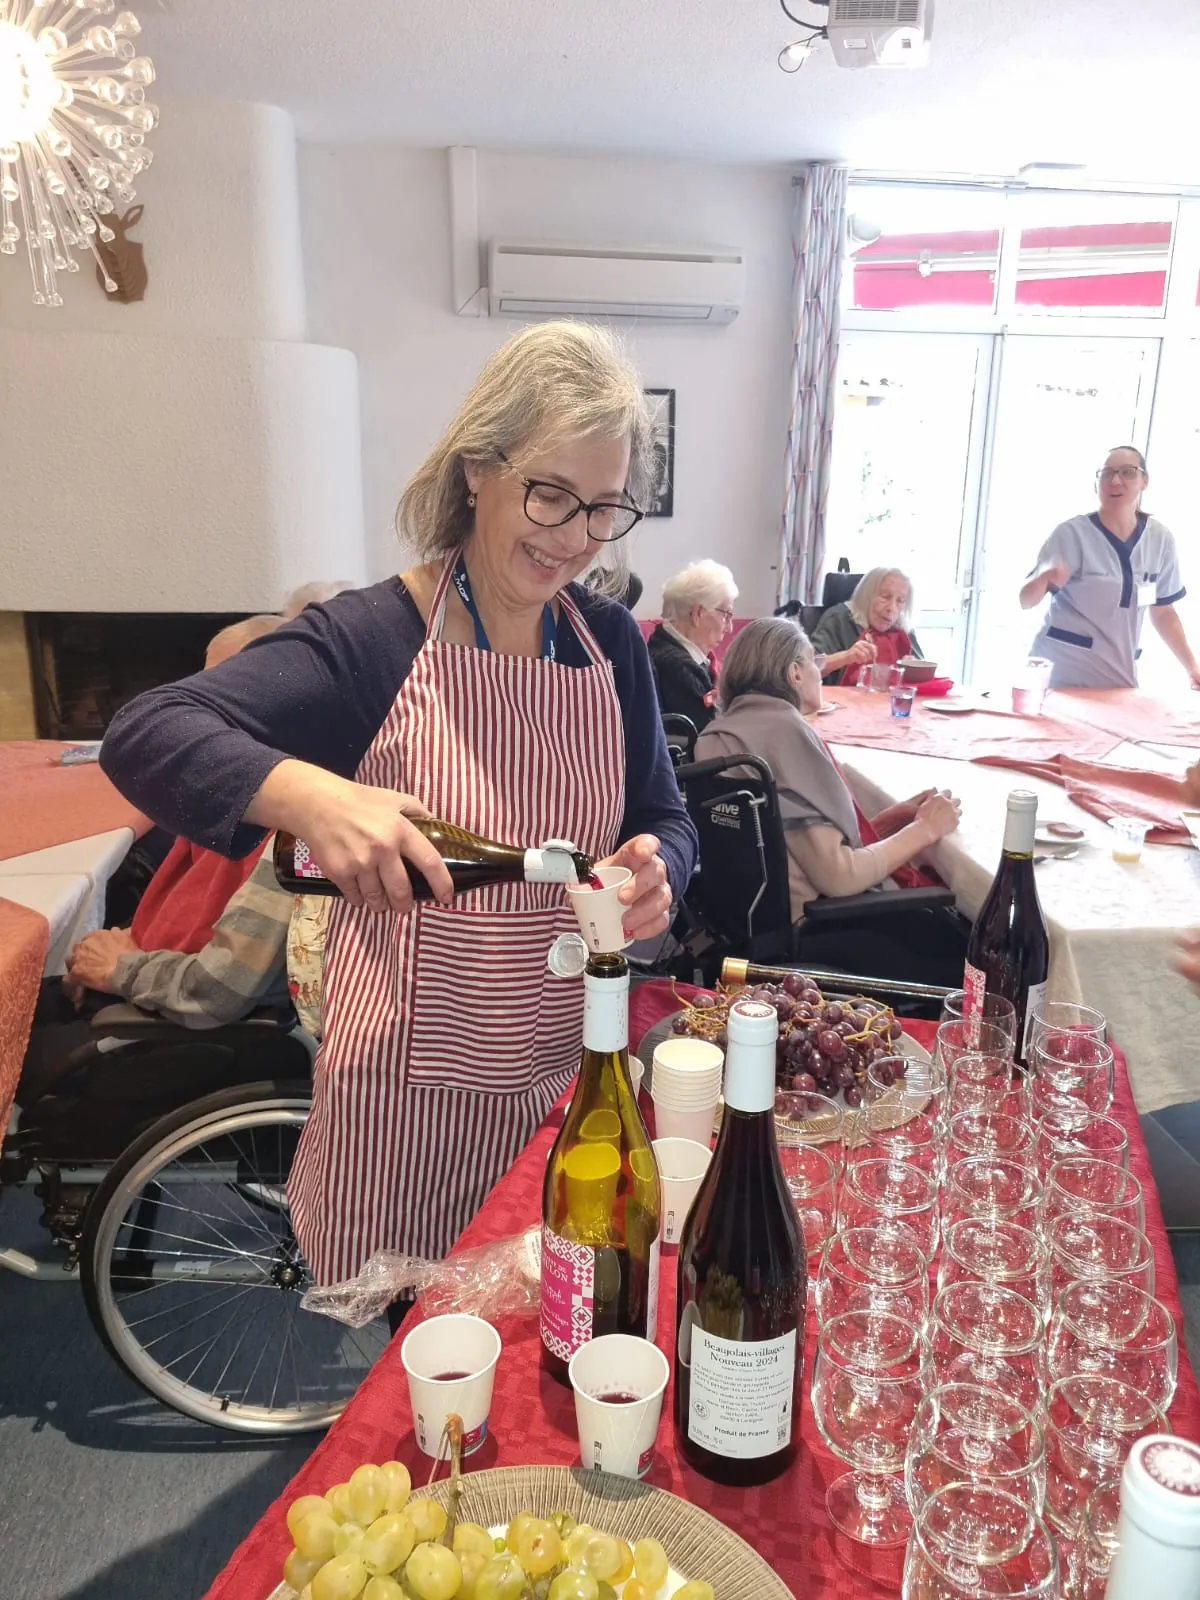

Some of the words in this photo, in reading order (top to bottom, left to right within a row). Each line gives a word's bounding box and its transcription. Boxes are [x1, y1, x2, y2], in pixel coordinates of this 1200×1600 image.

[704, 1339, 785, 1358] Beaujolais-villages
[710, 1352, 753, 1367] Nouveau
[756, 1355, 779, 1367] 2024
[714, 1426, 737, 1437] Produit
[748, 1429, 769, 1437] France
